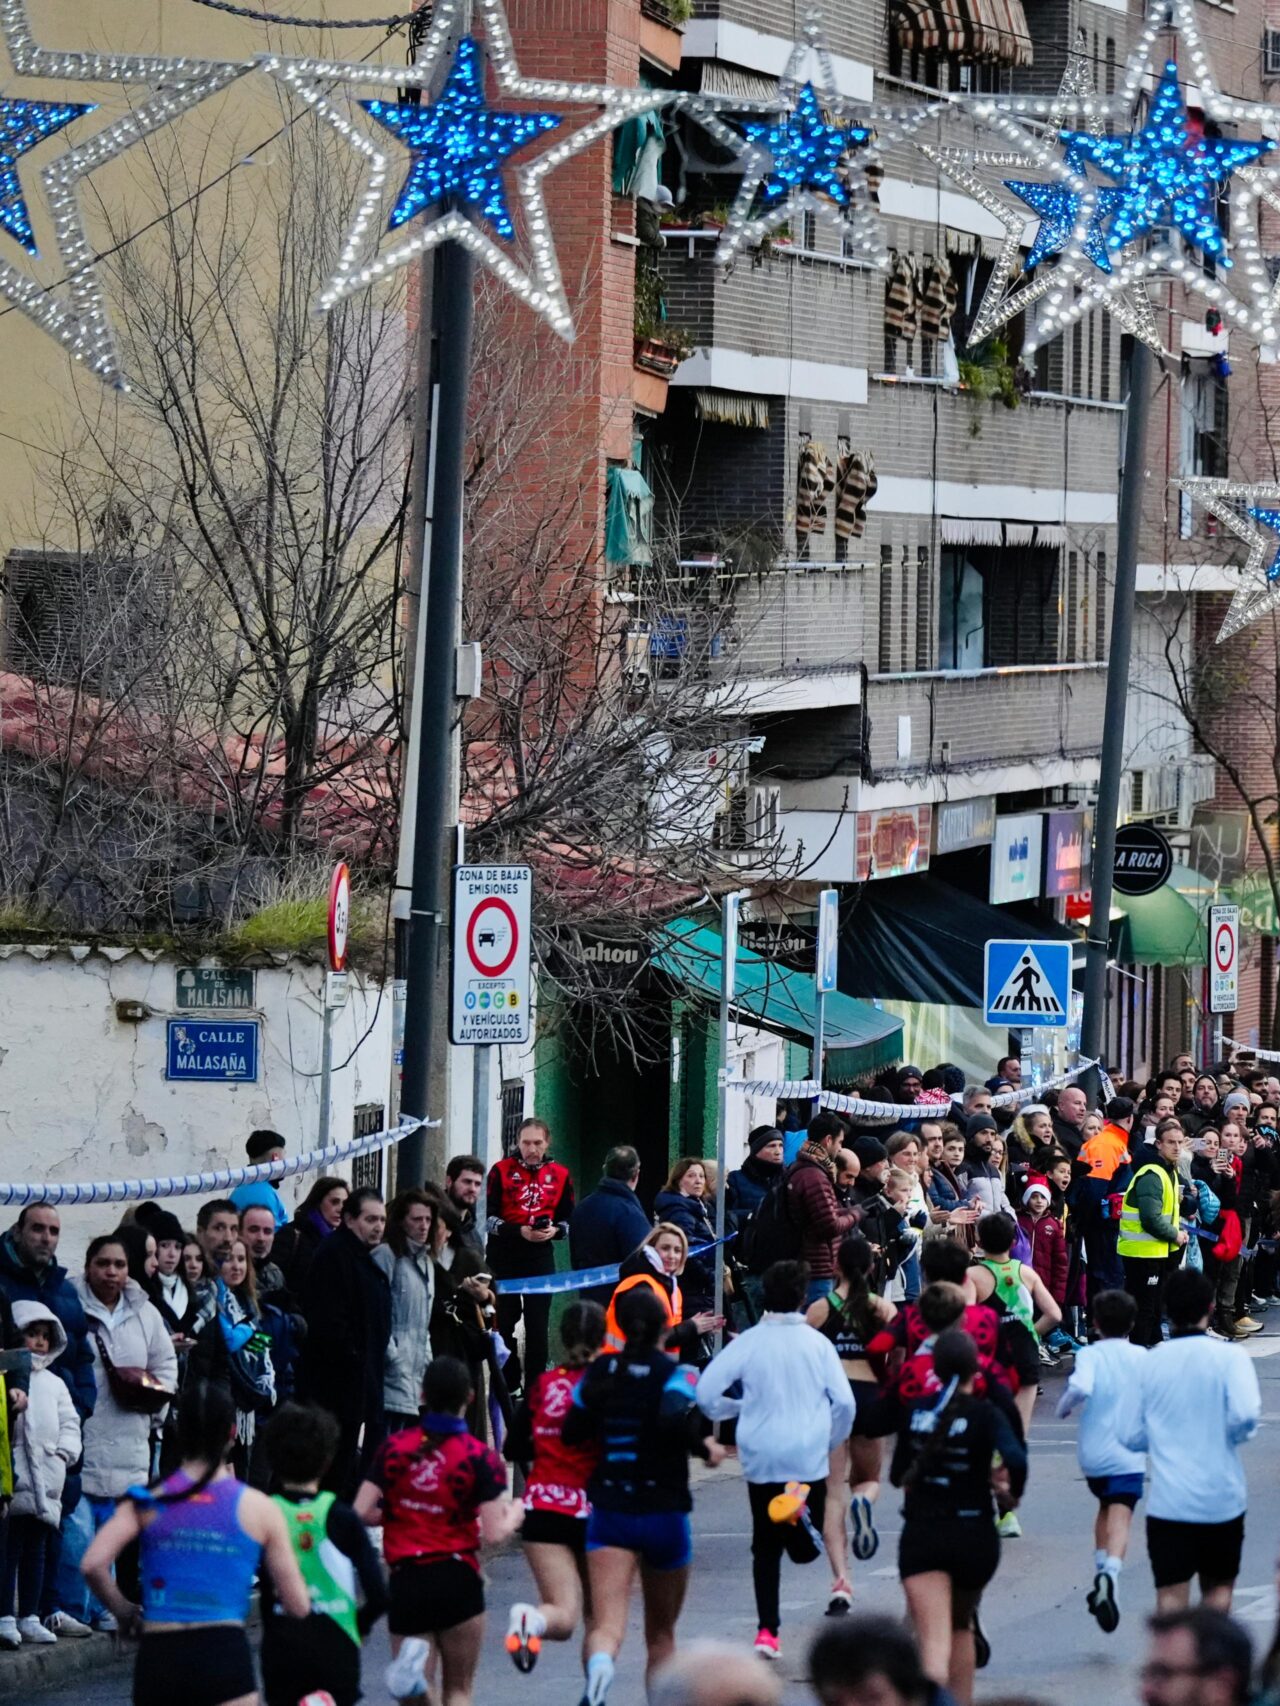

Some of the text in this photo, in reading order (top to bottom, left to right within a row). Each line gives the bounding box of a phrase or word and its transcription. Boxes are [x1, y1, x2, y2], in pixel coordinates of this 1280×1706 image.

[1128, 851, 1163, 869] ROCA
[459, 870, 528, 881] ZONA DE BAJAS
[468, 883, 519, 895] EMISIONES
[187, 986, 249, 1008] MALASAÑA
[462, 1011, 520, 1025] Y VEHÍCULOS
[199, 1031, 245, 1043] CALLE
[459, 1028, 522, 1040] AUTORIZADOS
[176, 1053, 247, 1071] MALASAÑA
